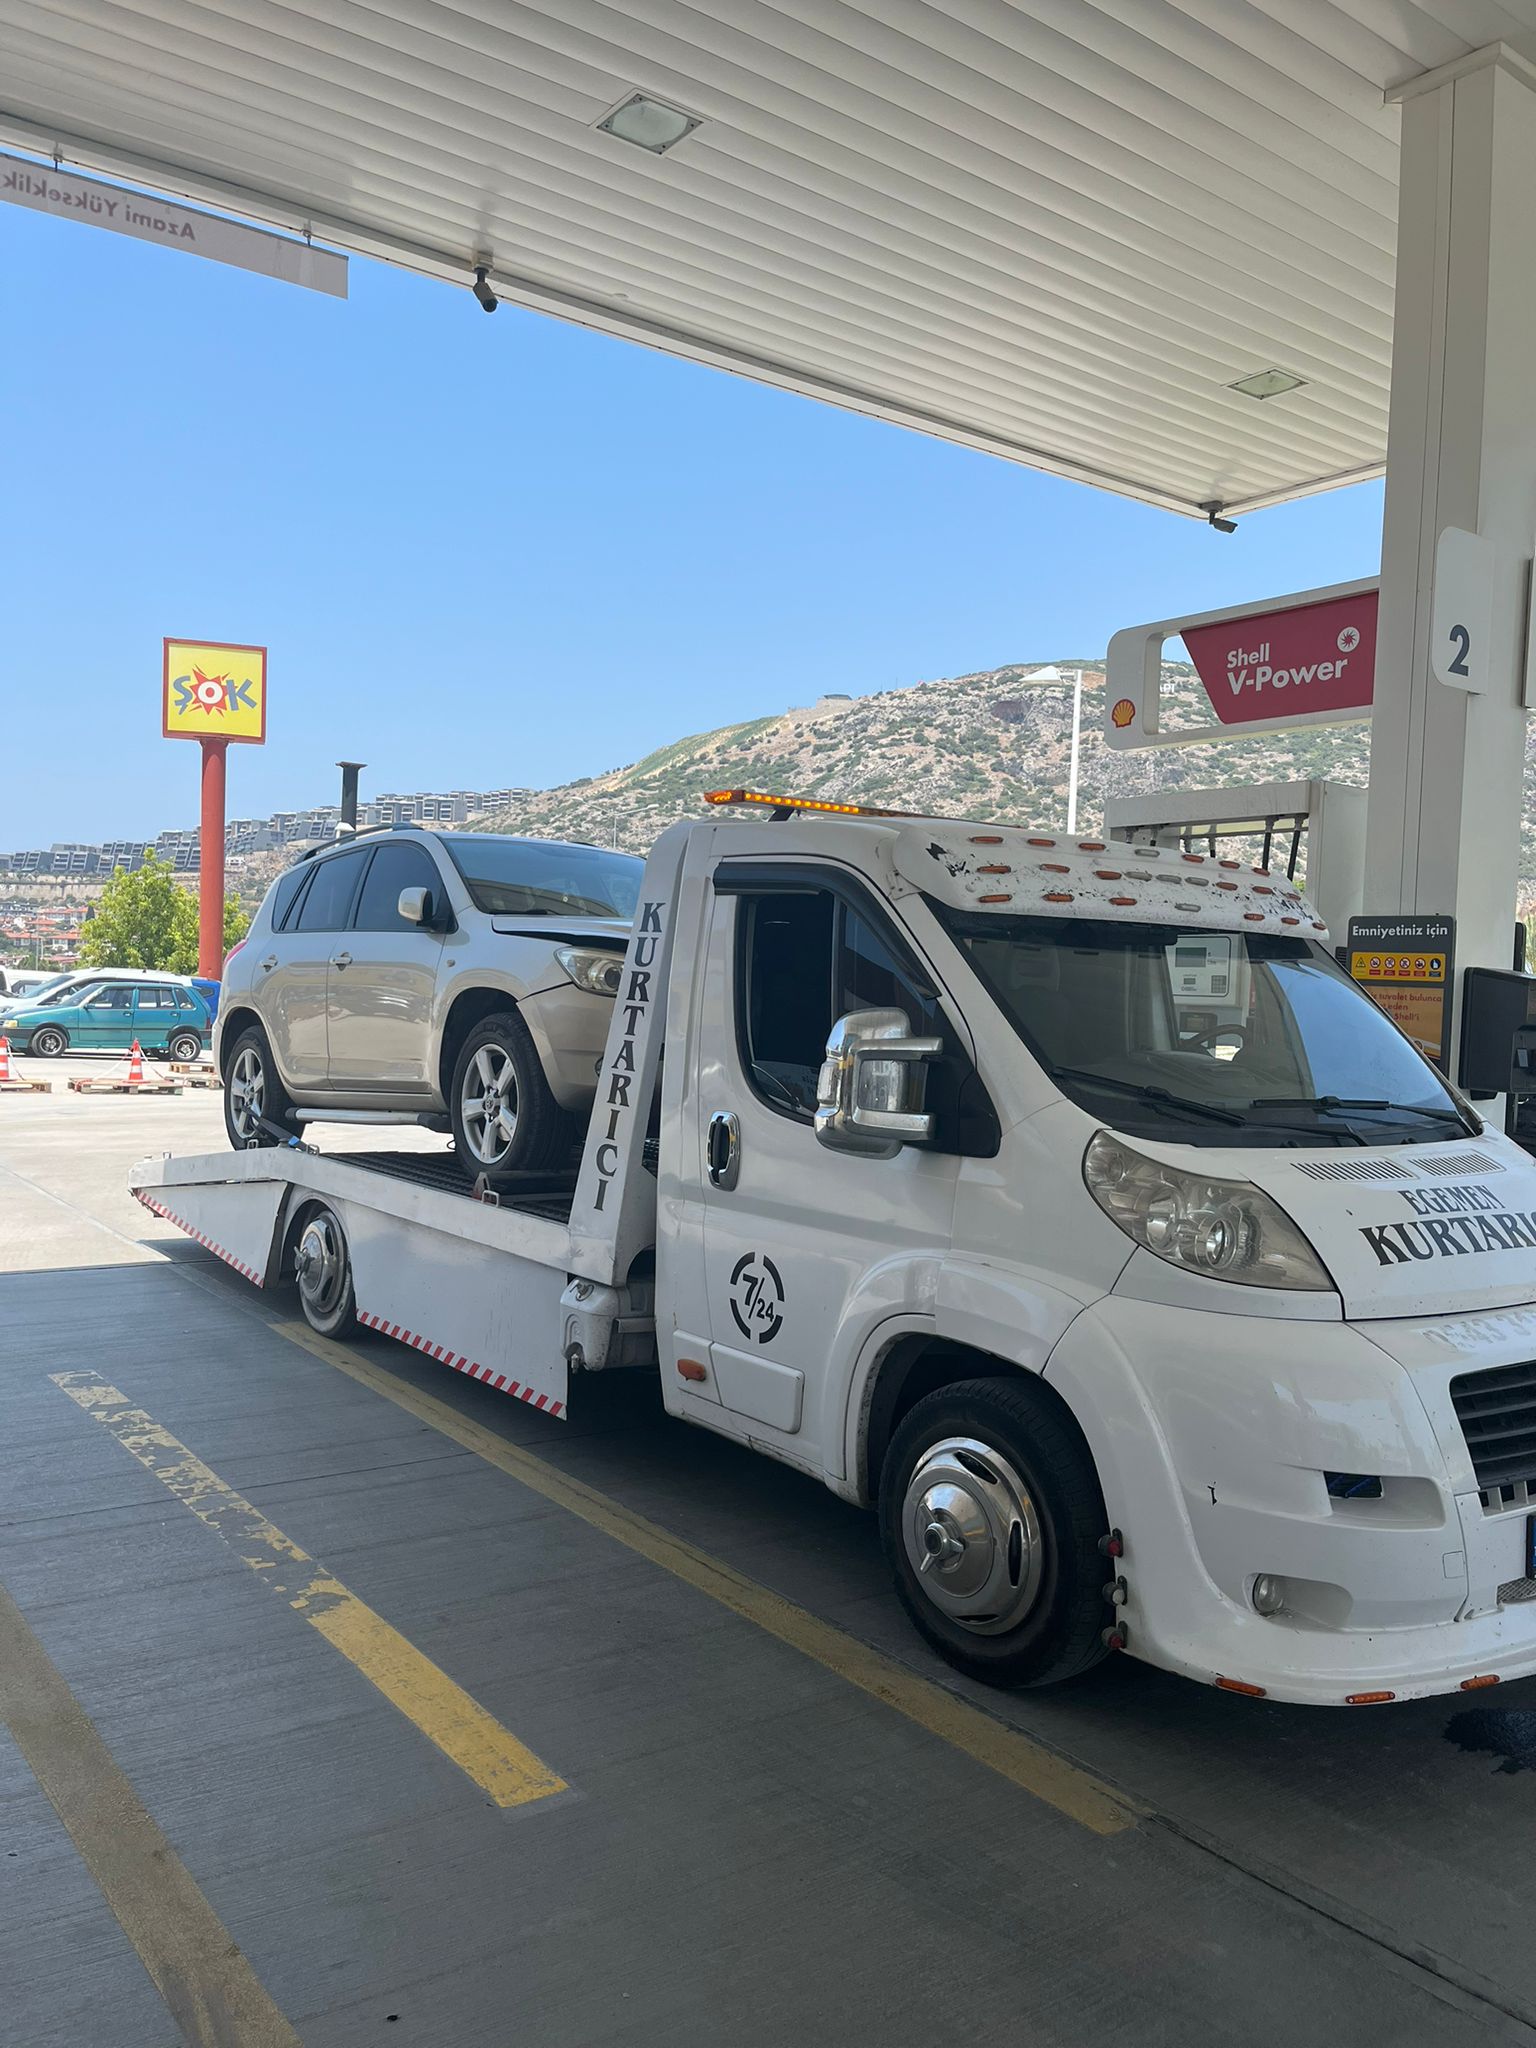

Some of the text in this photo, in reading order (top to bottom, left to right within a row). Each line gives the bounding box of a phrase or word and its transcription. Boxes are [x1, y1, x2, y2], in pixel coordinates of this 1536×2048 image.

[1226, 642, 1270, 668] Shell
[1448, 624, 1471, 677] 2
[173, 675, 257, 715] ŞOK
[1226, 656, 1349, 695] V-Power
[1352, 924, 1448, 939] Emniyetiniz için
[593, 902, 666, 1211] KURTARICI
[1397, 1185, 1505, 1215] EGEMEN
[1358, 1211, 1536, 1266] KURTARI
